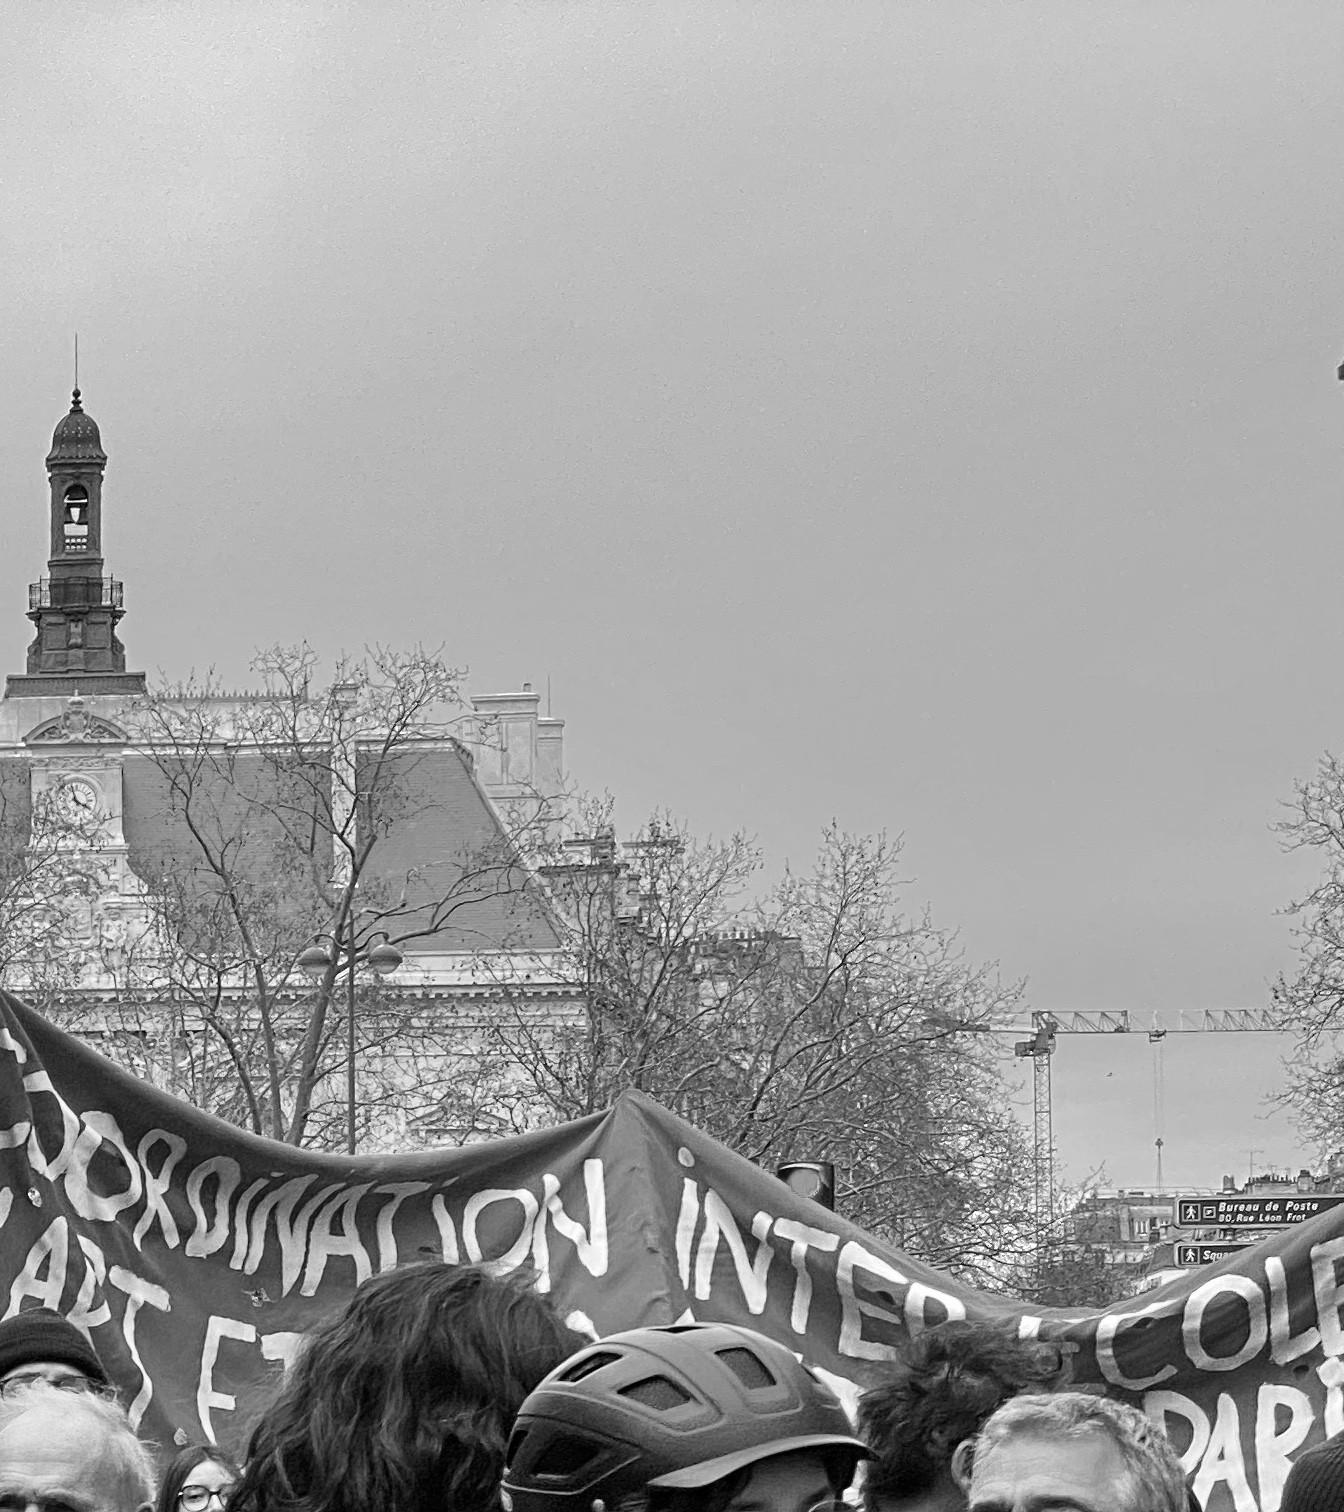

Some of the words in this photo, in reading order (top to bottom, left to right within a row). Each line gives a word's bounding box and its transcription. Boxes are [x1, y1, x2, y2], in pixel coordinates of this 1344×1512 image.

[1218, 1202, 1260, 1212] Bureau
[1265, 1202, 1279, 1212] de
[1285, 1201, 1319, 1211] Poste
[1259, 1213, 1282, 1222] Léon
[1286, 1213, 1306, 1222] Frot
